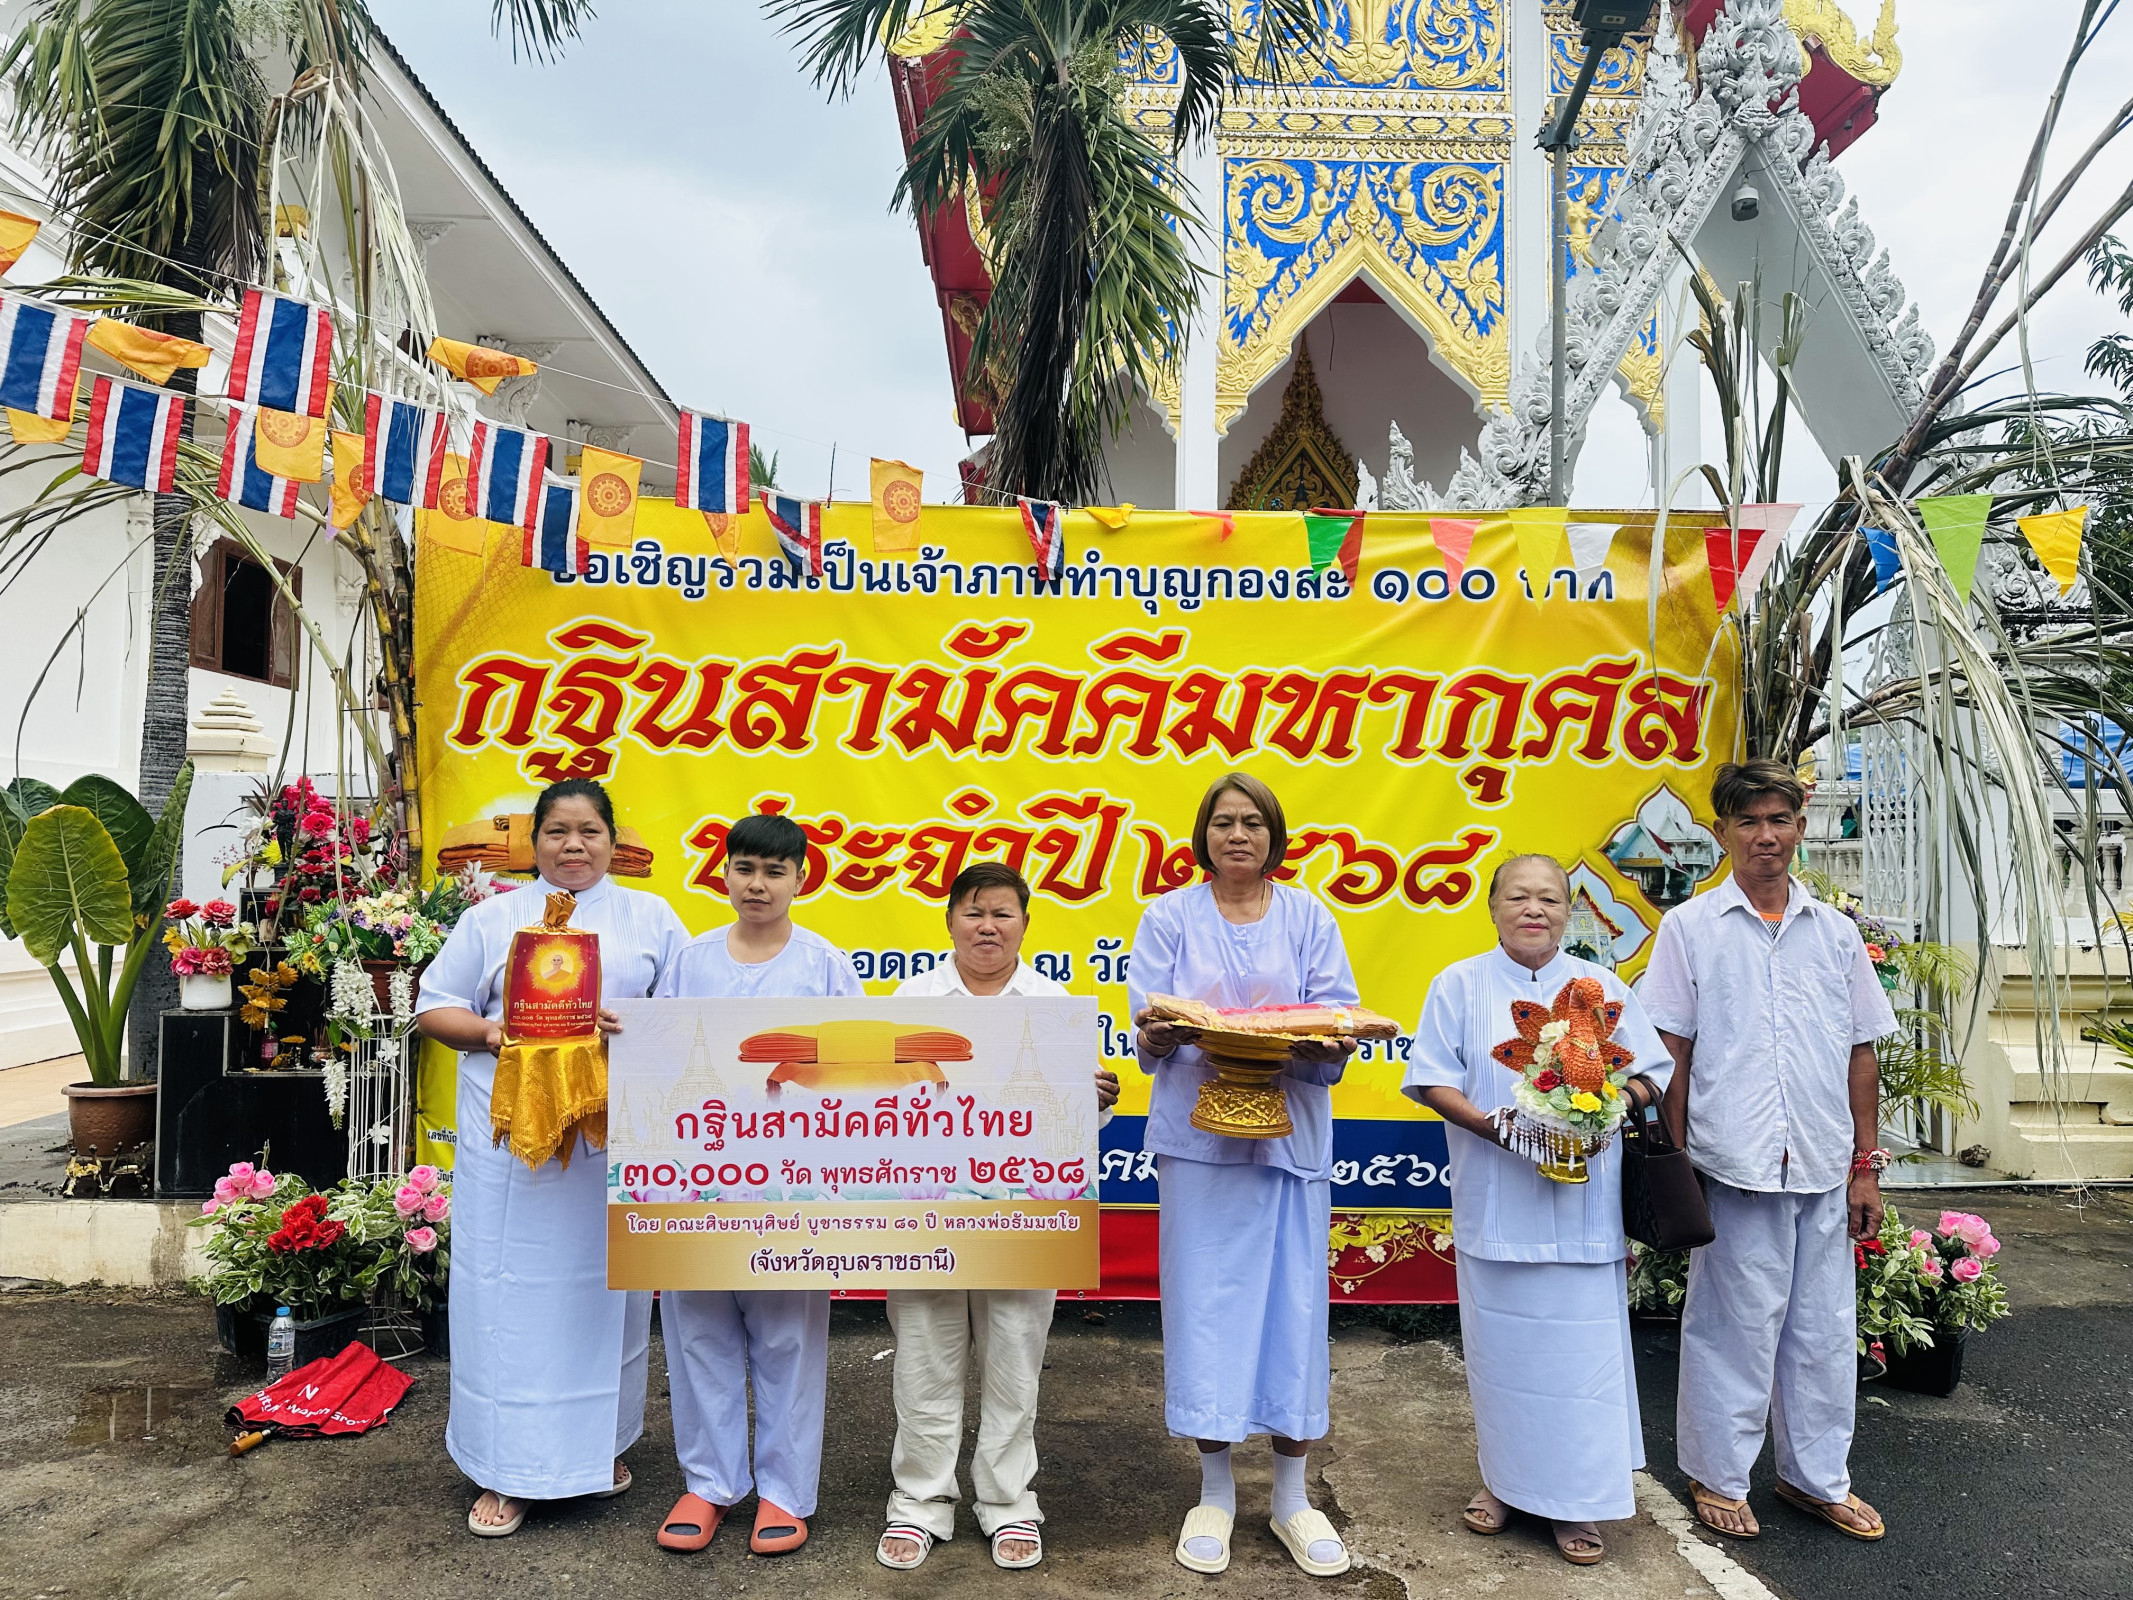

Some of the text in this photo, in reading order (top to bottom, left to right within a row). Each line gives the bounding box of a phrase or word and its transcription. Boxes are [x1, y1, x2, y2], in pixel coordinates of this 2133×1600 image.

[450, 622, 1711, 803] กฐินสามัคคีมหากุศล
[1035, 953, 1071, 981] ณ
[675, 1086, 1033, 1151] กฐินสามัคคีทั่วไทย
[624, 1156, 1086, 1193] ๓๐,๐๐๐ วัด พุทธศักราช ๒๕๖๘
[628, 1211, 1080, 1236] โดย คณะศิษยานุศิษย์ บูชาธรรม ๘๑ ปี หลวงพ่อธัมมชโย
[750, 1248, 956, 1279] (จังหวัดอุบลราชธานี)
